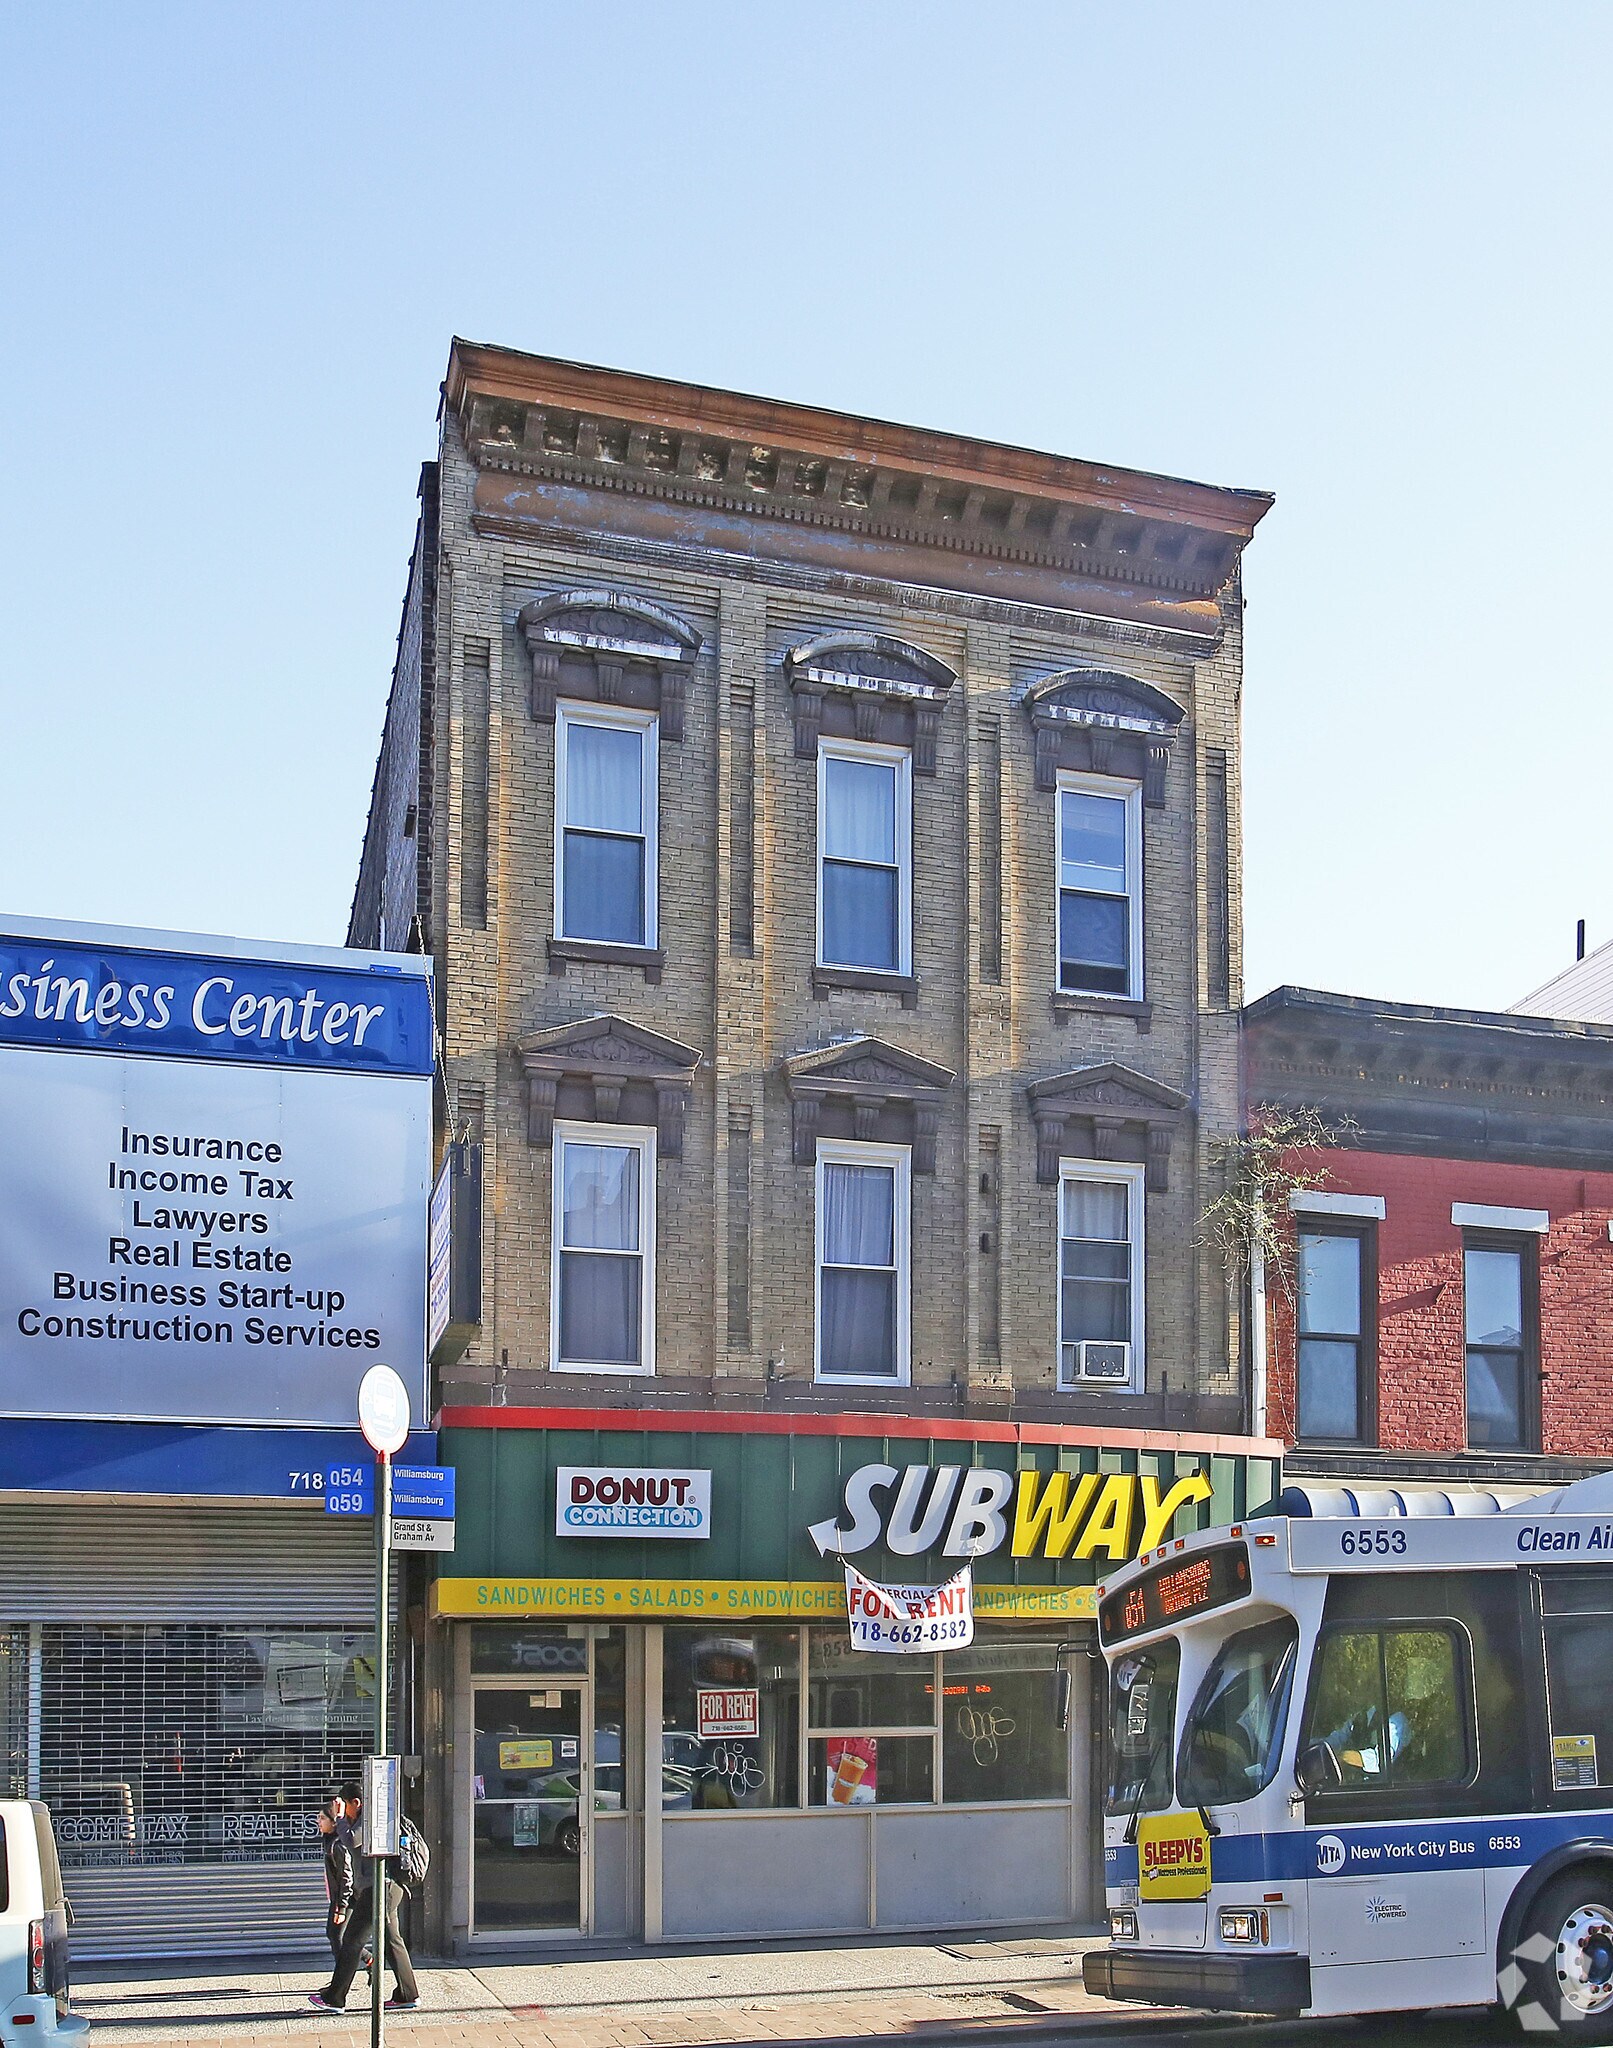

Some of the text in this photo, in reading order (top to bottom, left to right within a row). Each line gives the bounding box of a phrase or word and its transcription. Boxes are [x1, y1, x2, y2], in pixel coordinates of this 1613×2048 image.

[0, 958, 384, 1046] siness Center
[121, 1126, 283, 1163] Insurance
[108, 1162, 294, 1200] Income Tax
[132, 1201, 269, 1237] Lawyers
[108, 1237, 292, 1273] Real Estate
[53, 1272, 346, 1317] Business Start-up
[17, 1308, 381, 1350] Construction Services
[330, 1468, 364, 1487] Q54
[394, 1469, 444, 1480] Williamsburg
[329, 1494, 363, 1513] Q59
[394, 1494, 444, 1506] Williamsburg
[571, 1477, 692, 1505] DONUT
[569, 1507, 698, 1526] CONNECTION
[808, 1463, 1214, 1560] SUBWAY
[394, 1522, 432, 1533] Grand St &
[394, 1532, 435, 1542] Graham Av
[1340, 1530, 1407, 1555] 6553
[1516, 1526, 1581, 1552] Clean
[477, 1585, 605, 1606] SANDWICHES
[630, 1589, 704, 1606] SALADS
[973, 1591, 1069, 1610] ANDWICHES
[906, 1587, 966, 1620] RENT
[852, 1619, 967, 1644] 718-662-8582
[702, 1694, 754, 1720] FOR RENT
[52, 1816, 189, 1842] COME TAX
[222, 1815, 284, 1840] REAL
[1317, 1844, 1341, 1866] MTA
[1351, 1836, 1521, 1860] New York City Bus 6553
[1374, 1904, 1402, 1912] ELECTRIC
[1378, 1911, 1406, 1919] POWERED
